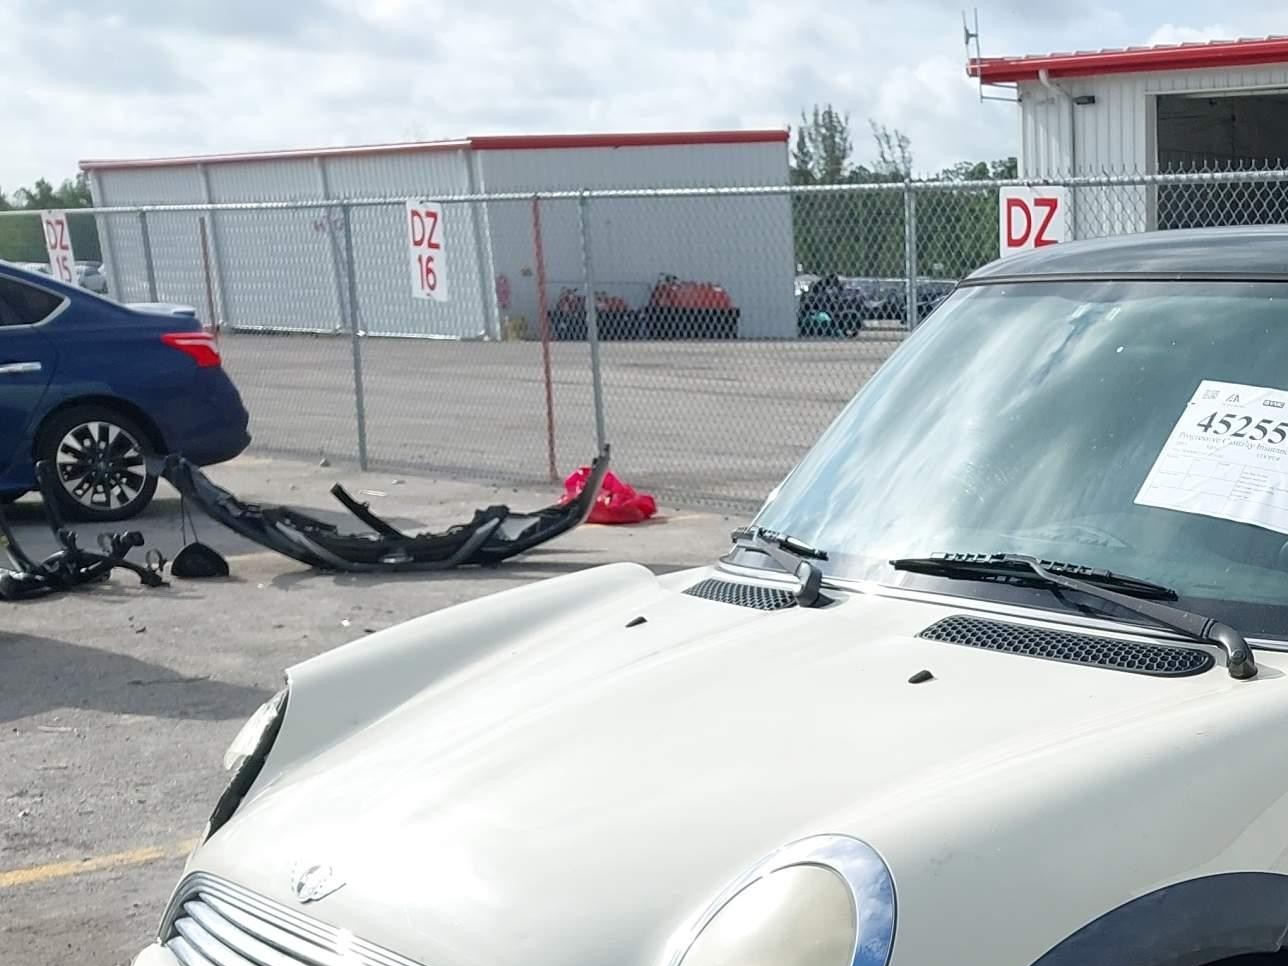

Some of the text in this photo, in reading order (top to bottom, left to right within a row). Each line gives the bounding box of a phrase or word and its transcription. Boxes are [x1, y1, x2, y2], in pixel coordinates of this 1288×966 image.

[46, 219, 69, 250] DZ
[411, 209, 440, 249] DZ
[1006, 198, 1058, 248] DZ
[56, 255, 72, 283] 15
[418, 254, 437, 291] 16
